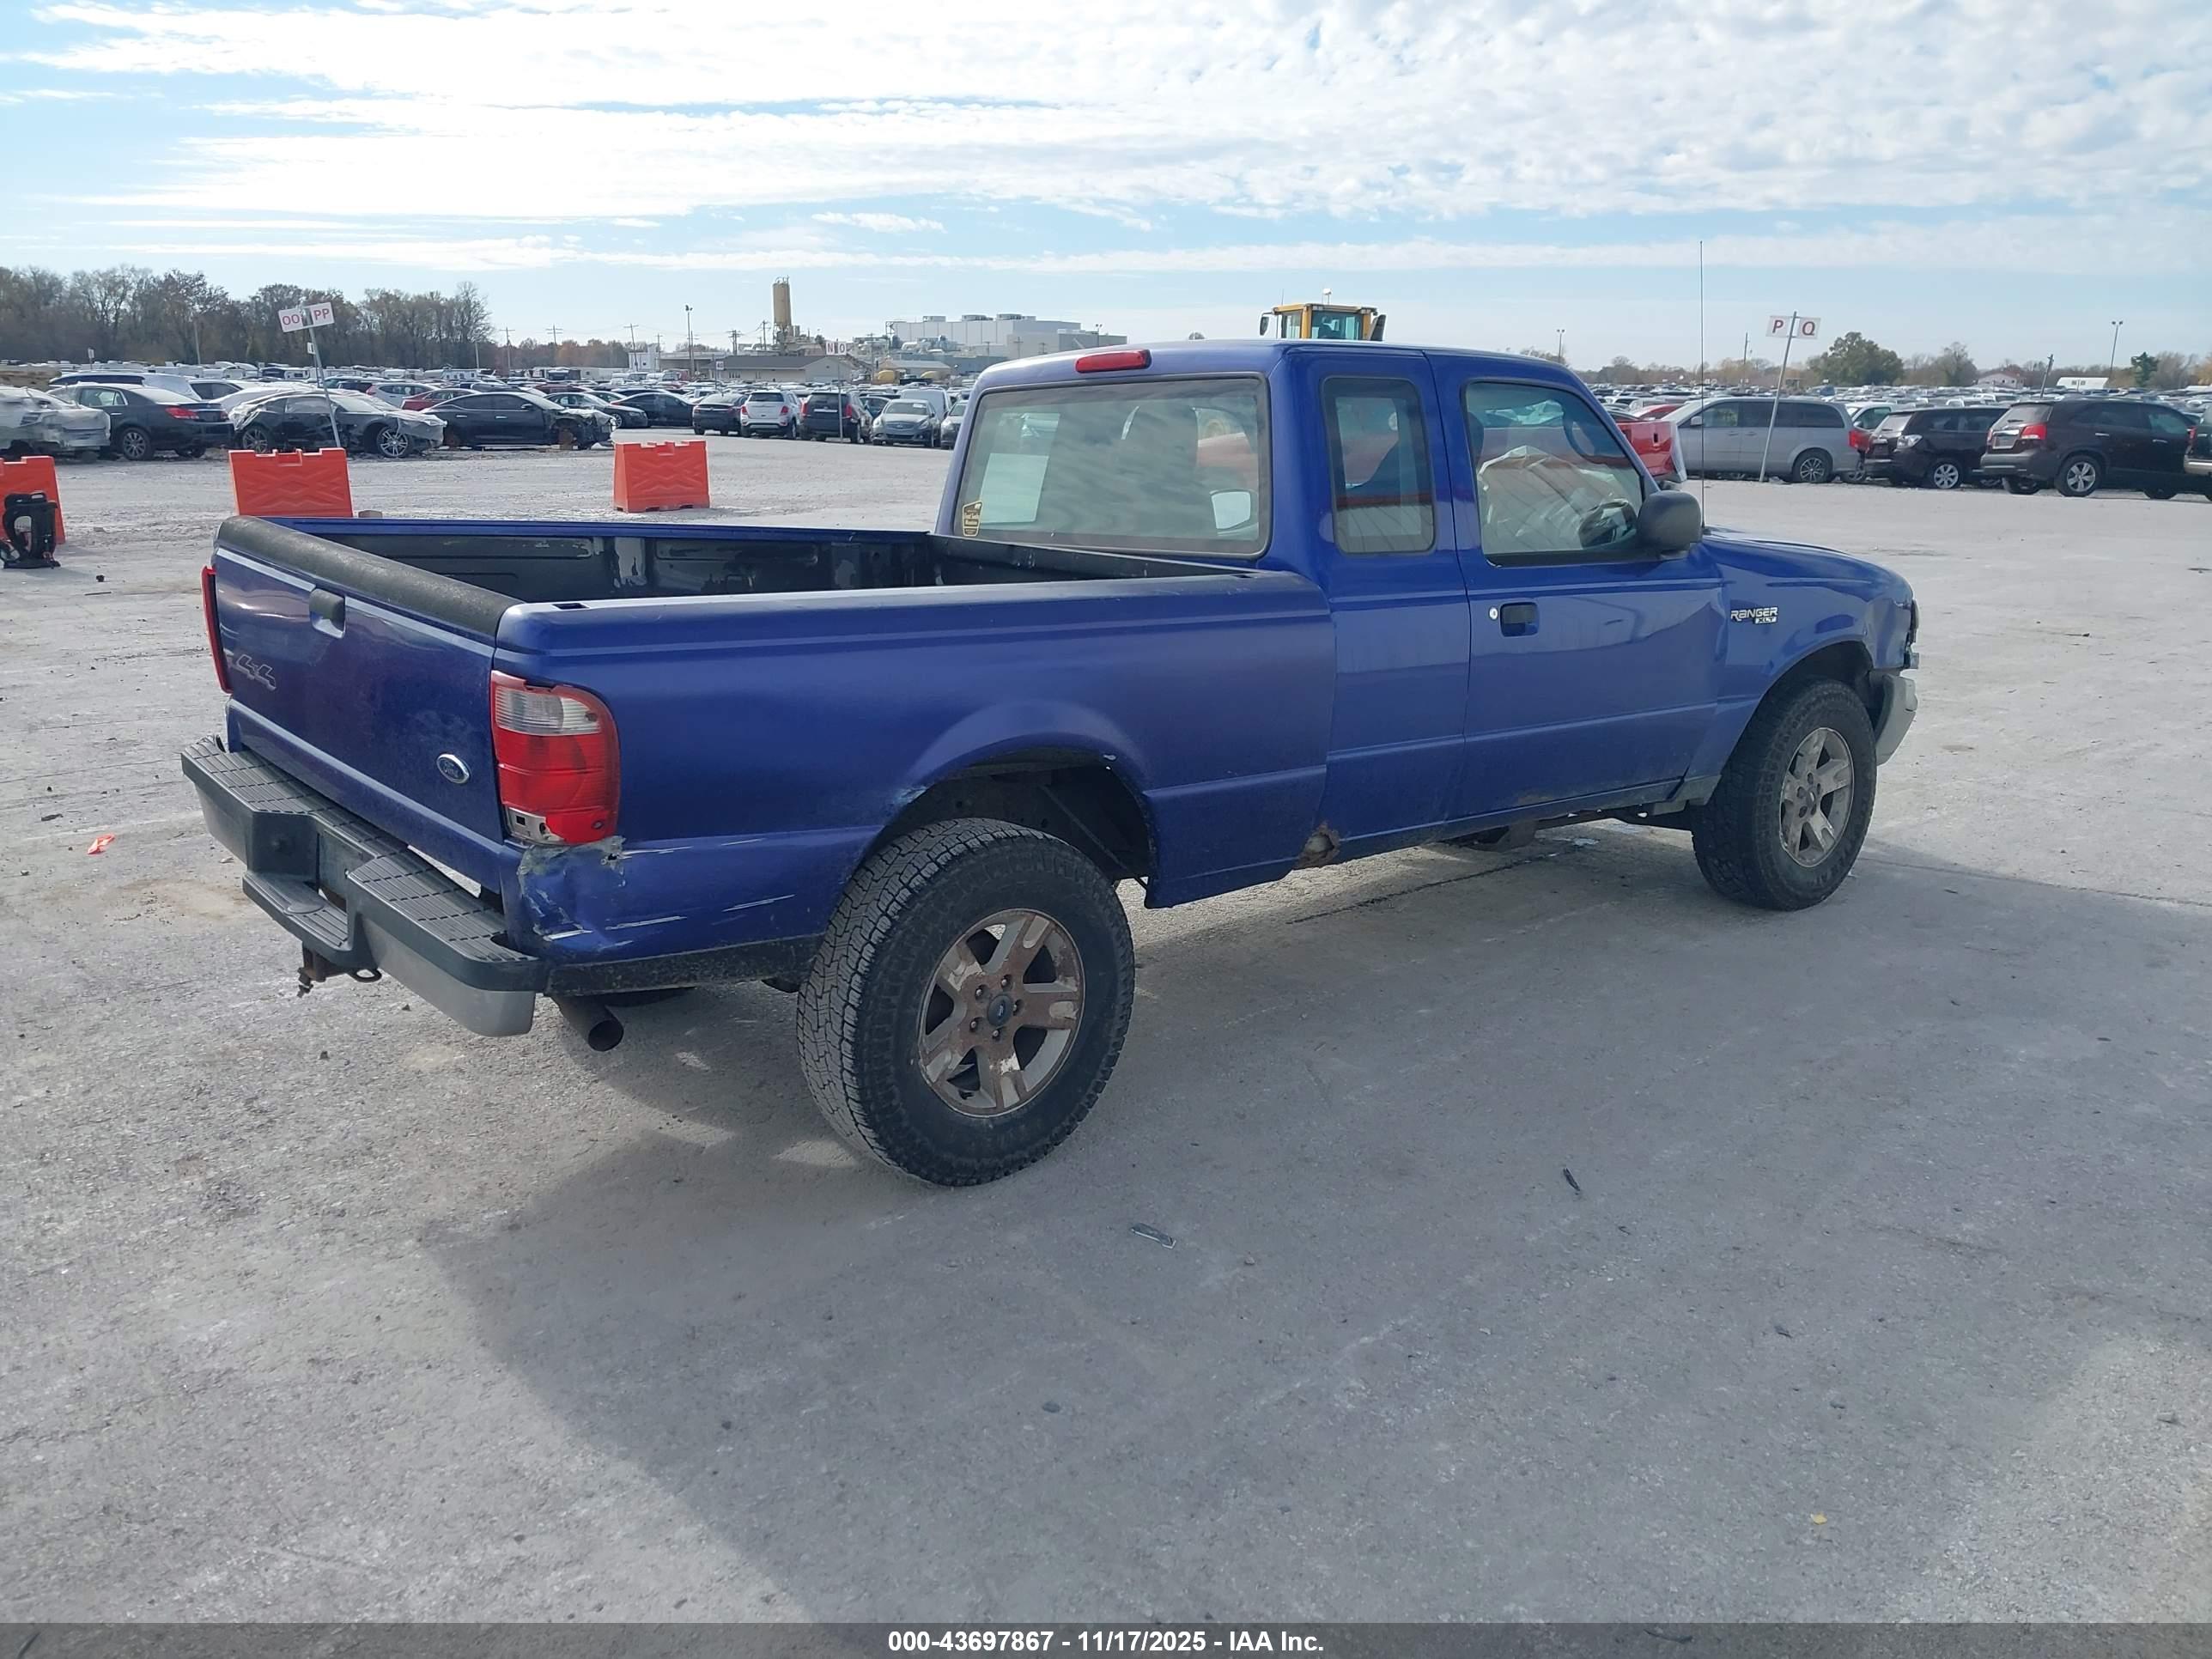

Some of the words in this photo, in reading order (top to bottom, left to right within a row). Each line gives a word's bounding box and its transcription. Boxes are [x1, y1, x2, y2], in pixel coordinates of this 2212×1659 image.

[282, 314, 300, 325] OO
[313, 308, 330, 320] PP
[1771, 319, 1784, 333] P
[1802, 321, 1815, 336] Q
[827, 343, 834, 353] N
[1730, 606, 1778, 622] RANGER
